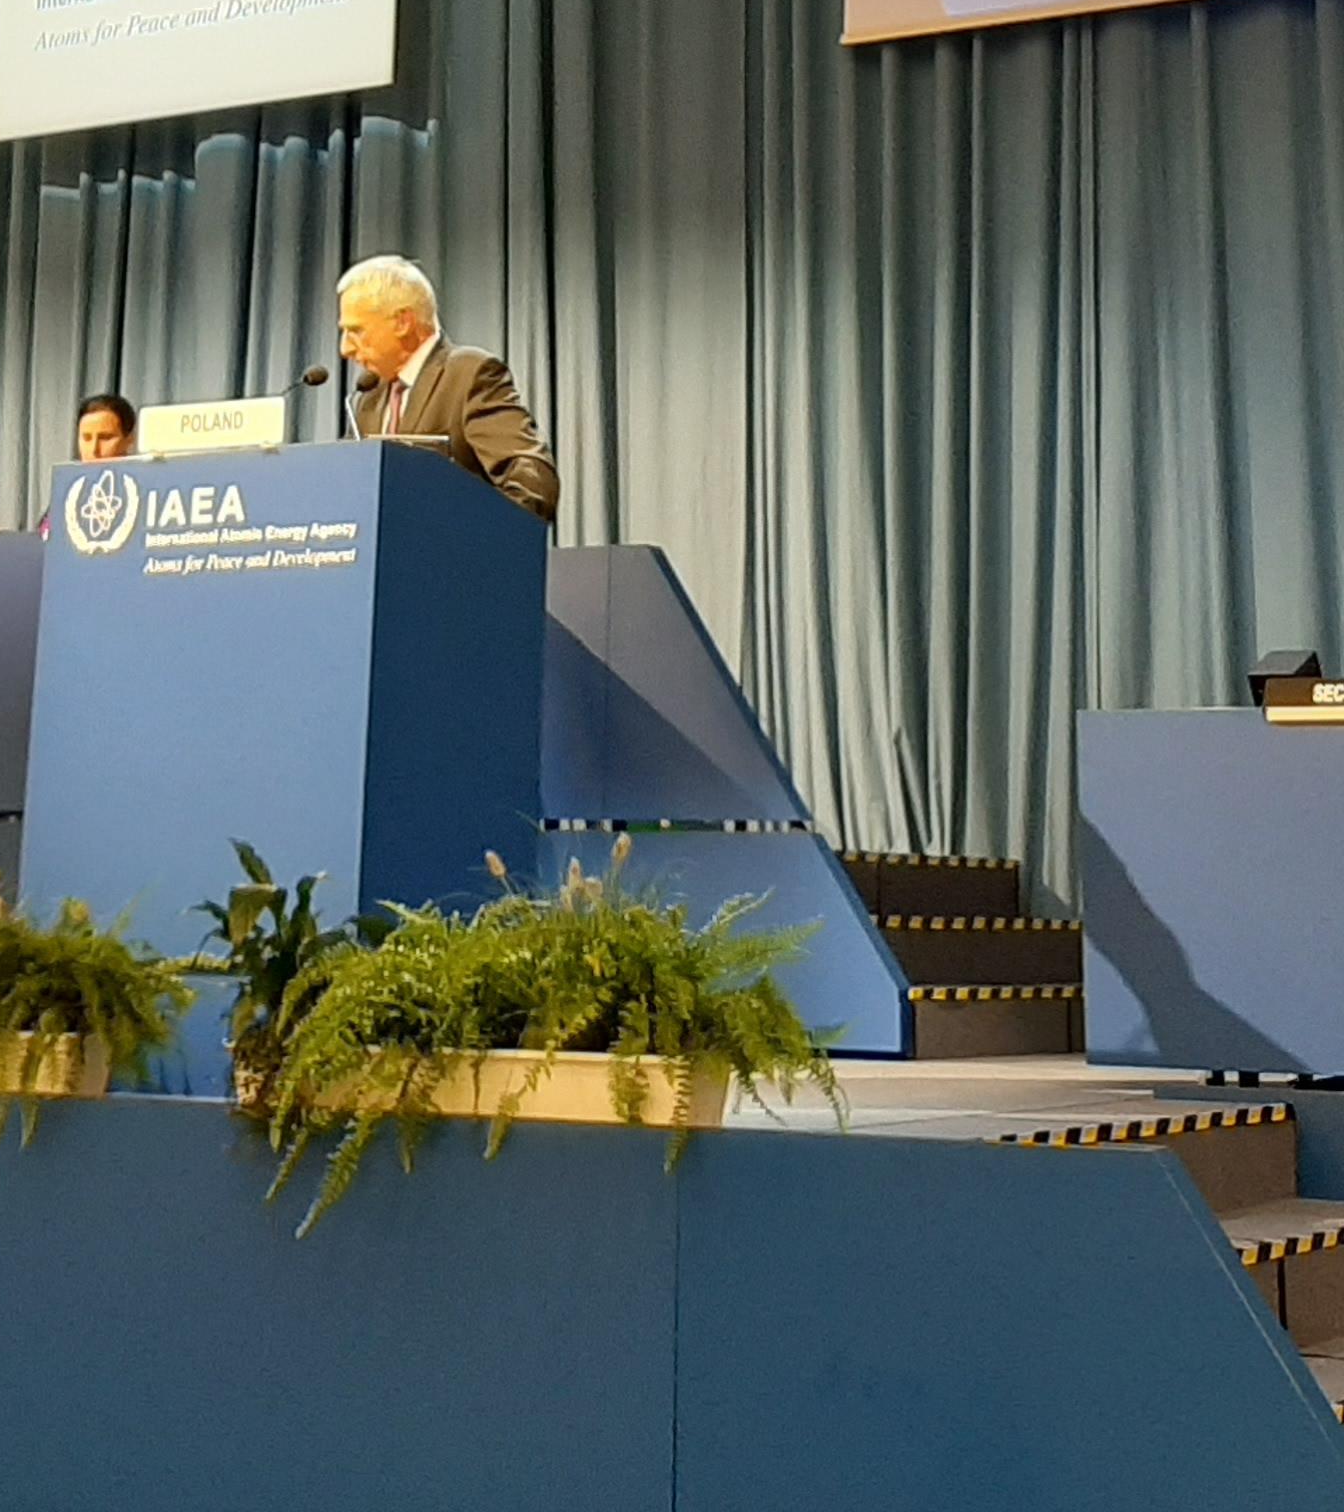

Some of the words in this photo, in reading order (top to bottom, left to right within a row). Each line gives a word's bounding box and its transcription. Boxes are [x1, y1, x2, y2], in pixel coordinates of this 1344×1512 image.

[34, 29, 89, 52] Atoms
[90, 20, 123, 47] for
[126, 13, 180, 39] Peace
[184, 1, 222, 27] and
[180, 410, 244, 433] POLAND
[145, 485, 246, 528] IAEA
